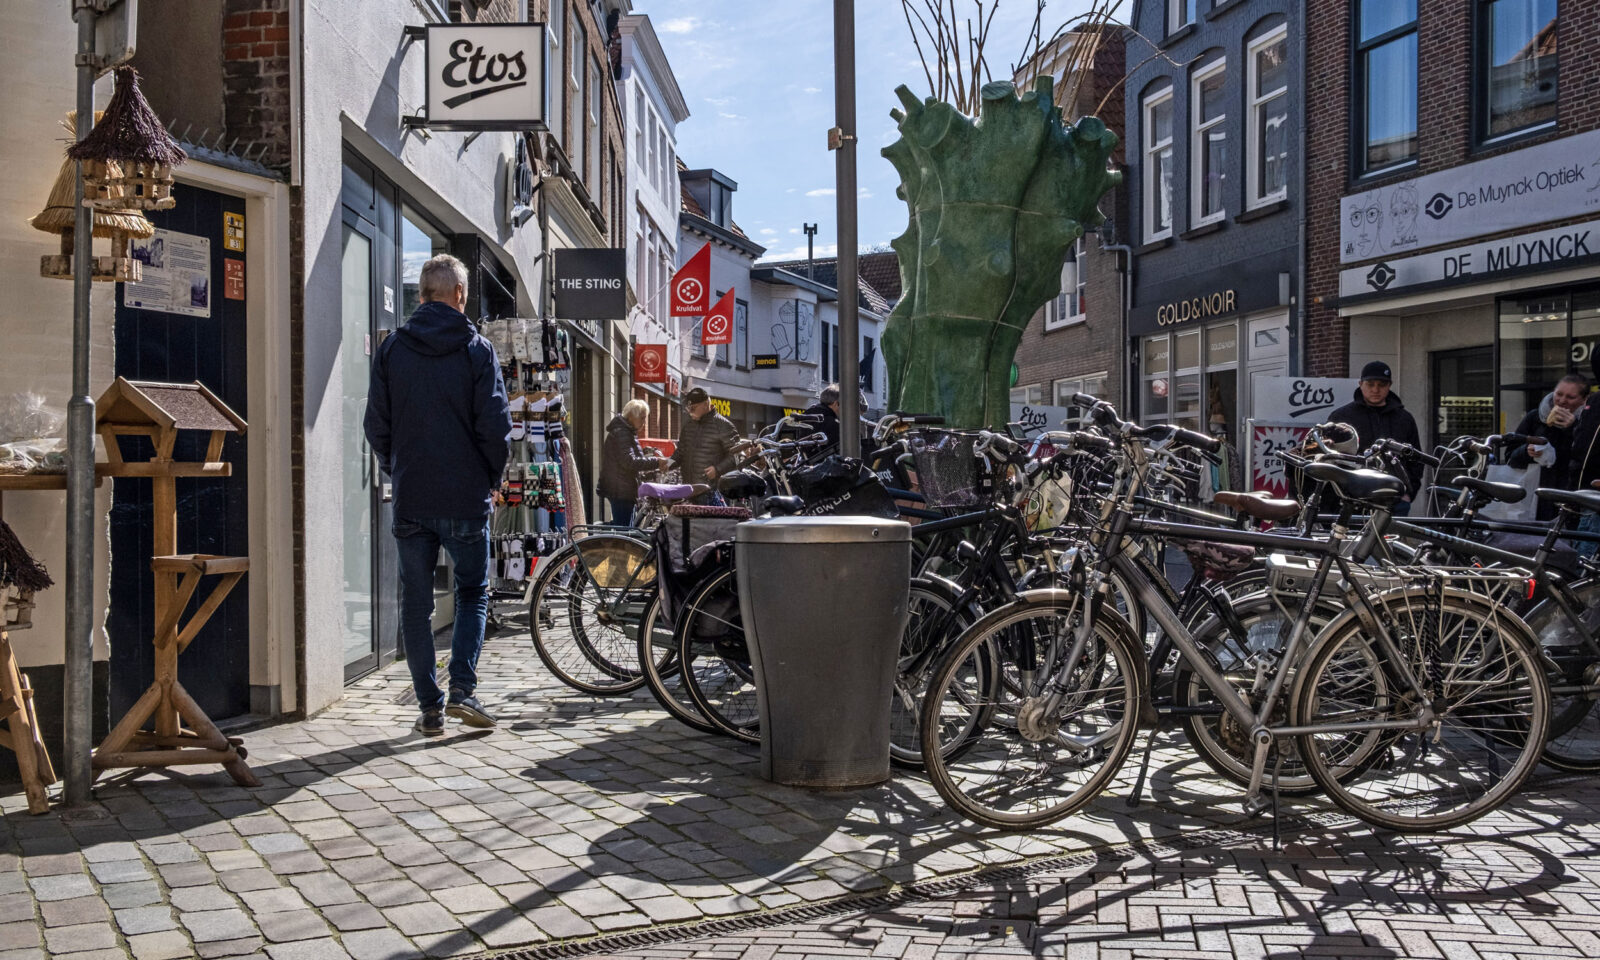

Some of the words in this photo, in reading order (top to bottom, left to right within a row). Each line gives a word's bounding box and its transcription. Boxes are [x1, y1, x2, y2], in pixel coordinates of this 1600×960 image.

[442, 39, 528, 89] Etos
[1458, 191, 1477, 209] De
[1479, 177, 1534, 204] Muynck
[1536, 163, 1585, 192] Optiek
[1444, 253, 1472, 279] DE
[1487, 230, 1592, 273] MUYNCK
[559, 278, 583, 290] THE
[585, 277, 622, 290] STING
[1157, 289, 1236, 326] GOLD&NOIR
[1289, 379, 1335, 407] Etos
[1020, 406, 1048, 426] Etos
